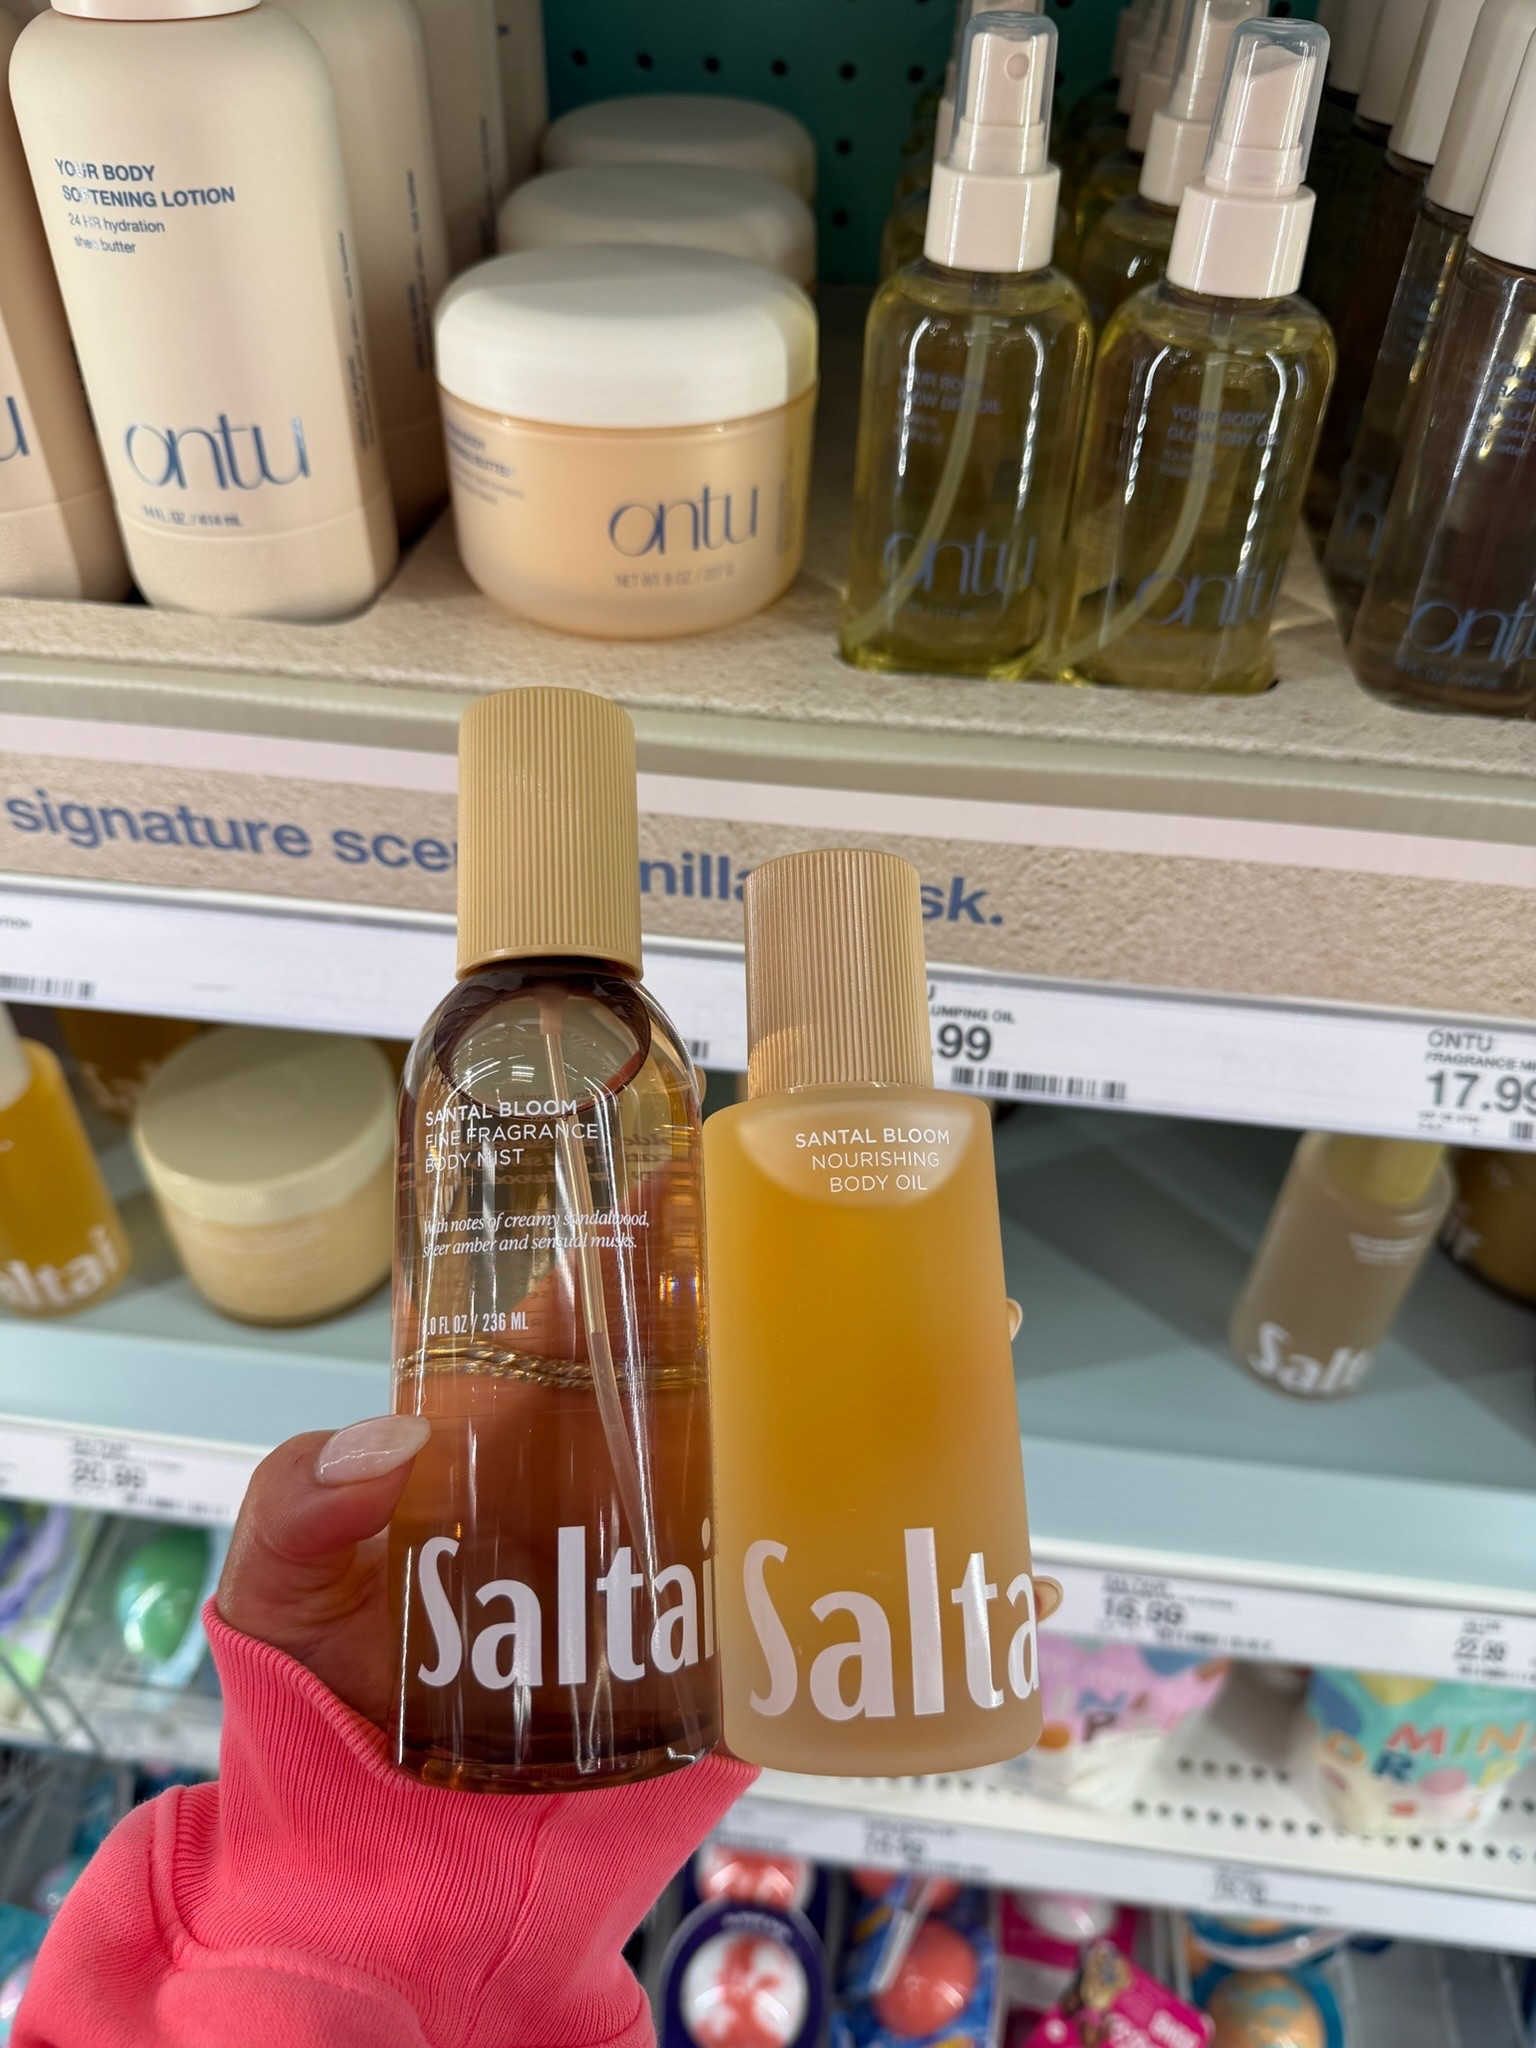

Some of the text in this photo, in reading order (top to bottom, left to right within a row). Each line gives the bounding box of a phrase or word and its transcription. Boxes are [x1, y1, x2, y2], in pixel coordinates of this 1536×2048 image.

[102, 164, 155, 182] BODY
[161, 186, 236, 208] LOTION
[67, 212, 81, 227] 24
[103, 217, 165, 234] hydration
[100, 238, 136, 254] butter
[6, 787, 1003, 927] signature sce nill sk.
[929, 1004, 1017, 1025] UMPING OIL
[1427, 1027, 1494, 1054] ONTU
[1424, 1049, 1518, 1071] FRAGRANCE
[425, 1099, 578, 1128] SANTAL BLOOM
[425, 1122, 600, 1150] FINE FRAGRANCE
[795, 1127, 951, 1149] SANTAL BLOOM
[425, 1148, 525, 1174] BODY MIST
[812, 1151, 940, 1171] NOURISHING
[830, 1174, 928, 1193] BODY OIL
[450, 1216, 485, 1233] notes
[487, 1211, 505, 1232] of
[504, 1214, 561, 1231] creamy
[452, 1238, 497, 1256] amber
[499, 1233, 530, 1252] and
[531, 1233, 588, 1250] sensual
[439, 1315, 450, 1334] FL
[453, 1314, 468, 1334] OZ
[482, 1312, 507, 1332] 236
[511, 1311, 529, 1331] ML
[416, 1516, 715, 1692] Saltai
